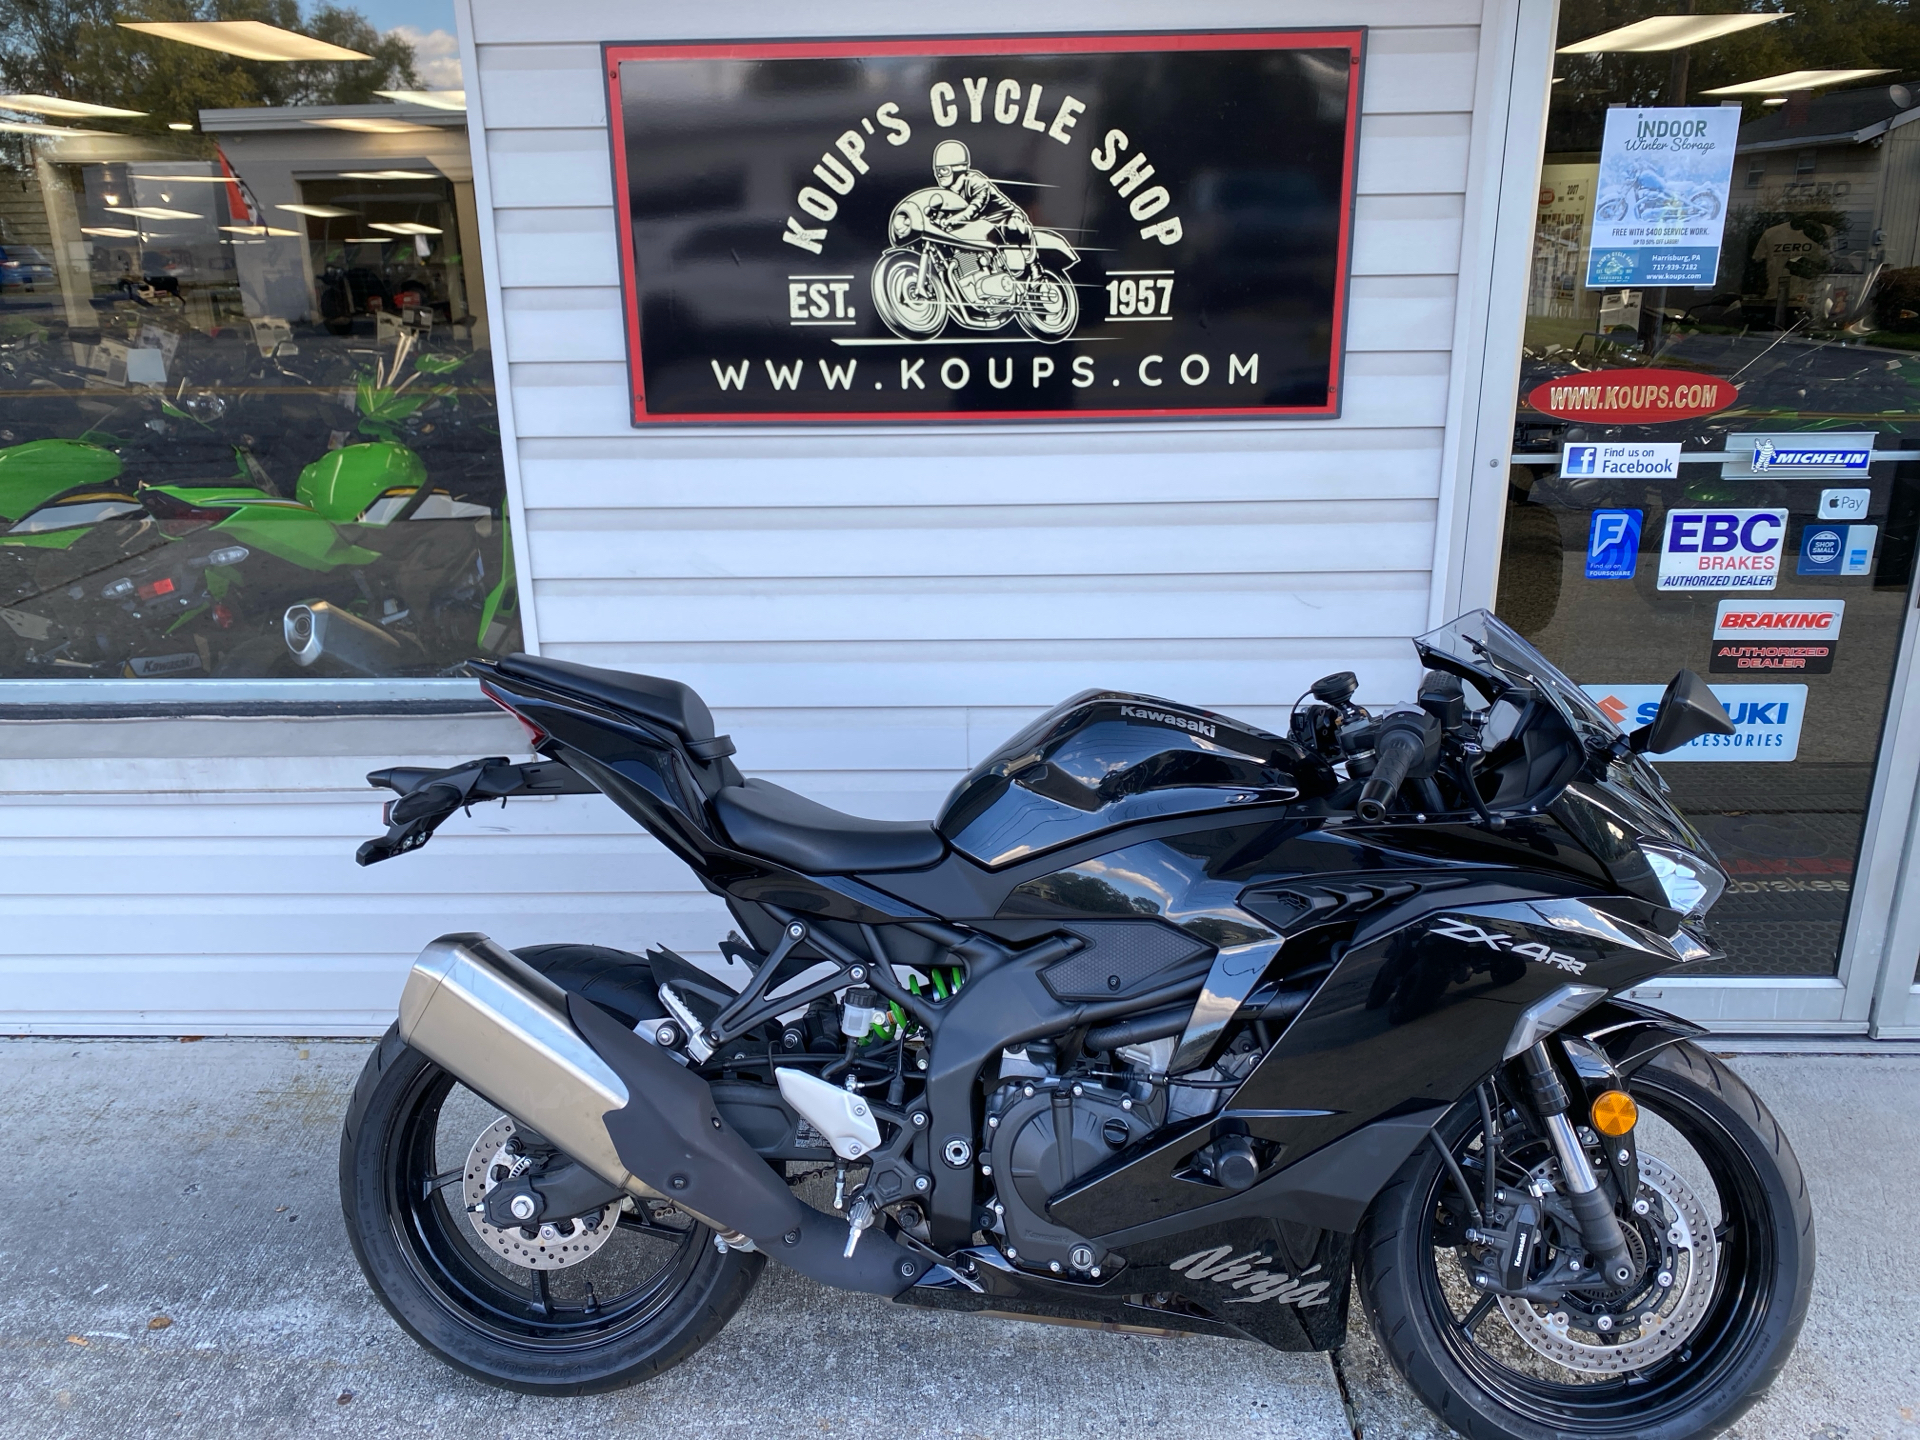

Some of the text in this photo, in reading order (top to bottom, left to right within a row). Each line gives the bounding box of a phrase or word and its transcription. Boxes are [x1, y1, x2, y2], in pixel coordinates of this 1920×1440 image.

[1637, 113, 1708, 138] INDOOR
[1624, 136, 1715, 155] Winter Storage
[782, 77, 1183, 255] KOUP'S CYCLE SHOP
[1612, 227, 1710, 236] FREE WITH $400 SERVICE WORK.
[1773, 242, 1812, 252] ZERO
[1652, 254, 1691, 263] Harrisburg,
[1652, 263, 1698, 271] 717-939-7182
[1646, 272, 1702, 280] www.koups.com
[789, 283, 856, 319] EST.
[1106, 279, 1174, 315] 1957
[1550, 384, 1718, 410] WWW.KOUPS.COM
[1603, 447, 1654, 457] Find us on
[1775, 451, 1867, 465] MICHELIN
[1602, 458, 1673, 474] Facebook
[1841, 496, 1864, 512] Pay
[1668, 513, 1782, 553] EBC
[1698, 555, 1775, 570] BRAKES
[1663, 575, 1774, 587] AUTHORIZED DEALER
[1720, 612, 1834, 630] BRAKING
[1718, 646, 1829, 657] AUTHORIZED
[1737, 658, 1806, 669] DEALER
[1635, 702, 1790, 725] SUKI
[1120, 705, 1216, 739] Kawasaki
[1513, 1232, 1528, 1268] Kawasaki
[1169, 1245, 1330, 1308] Ninja
